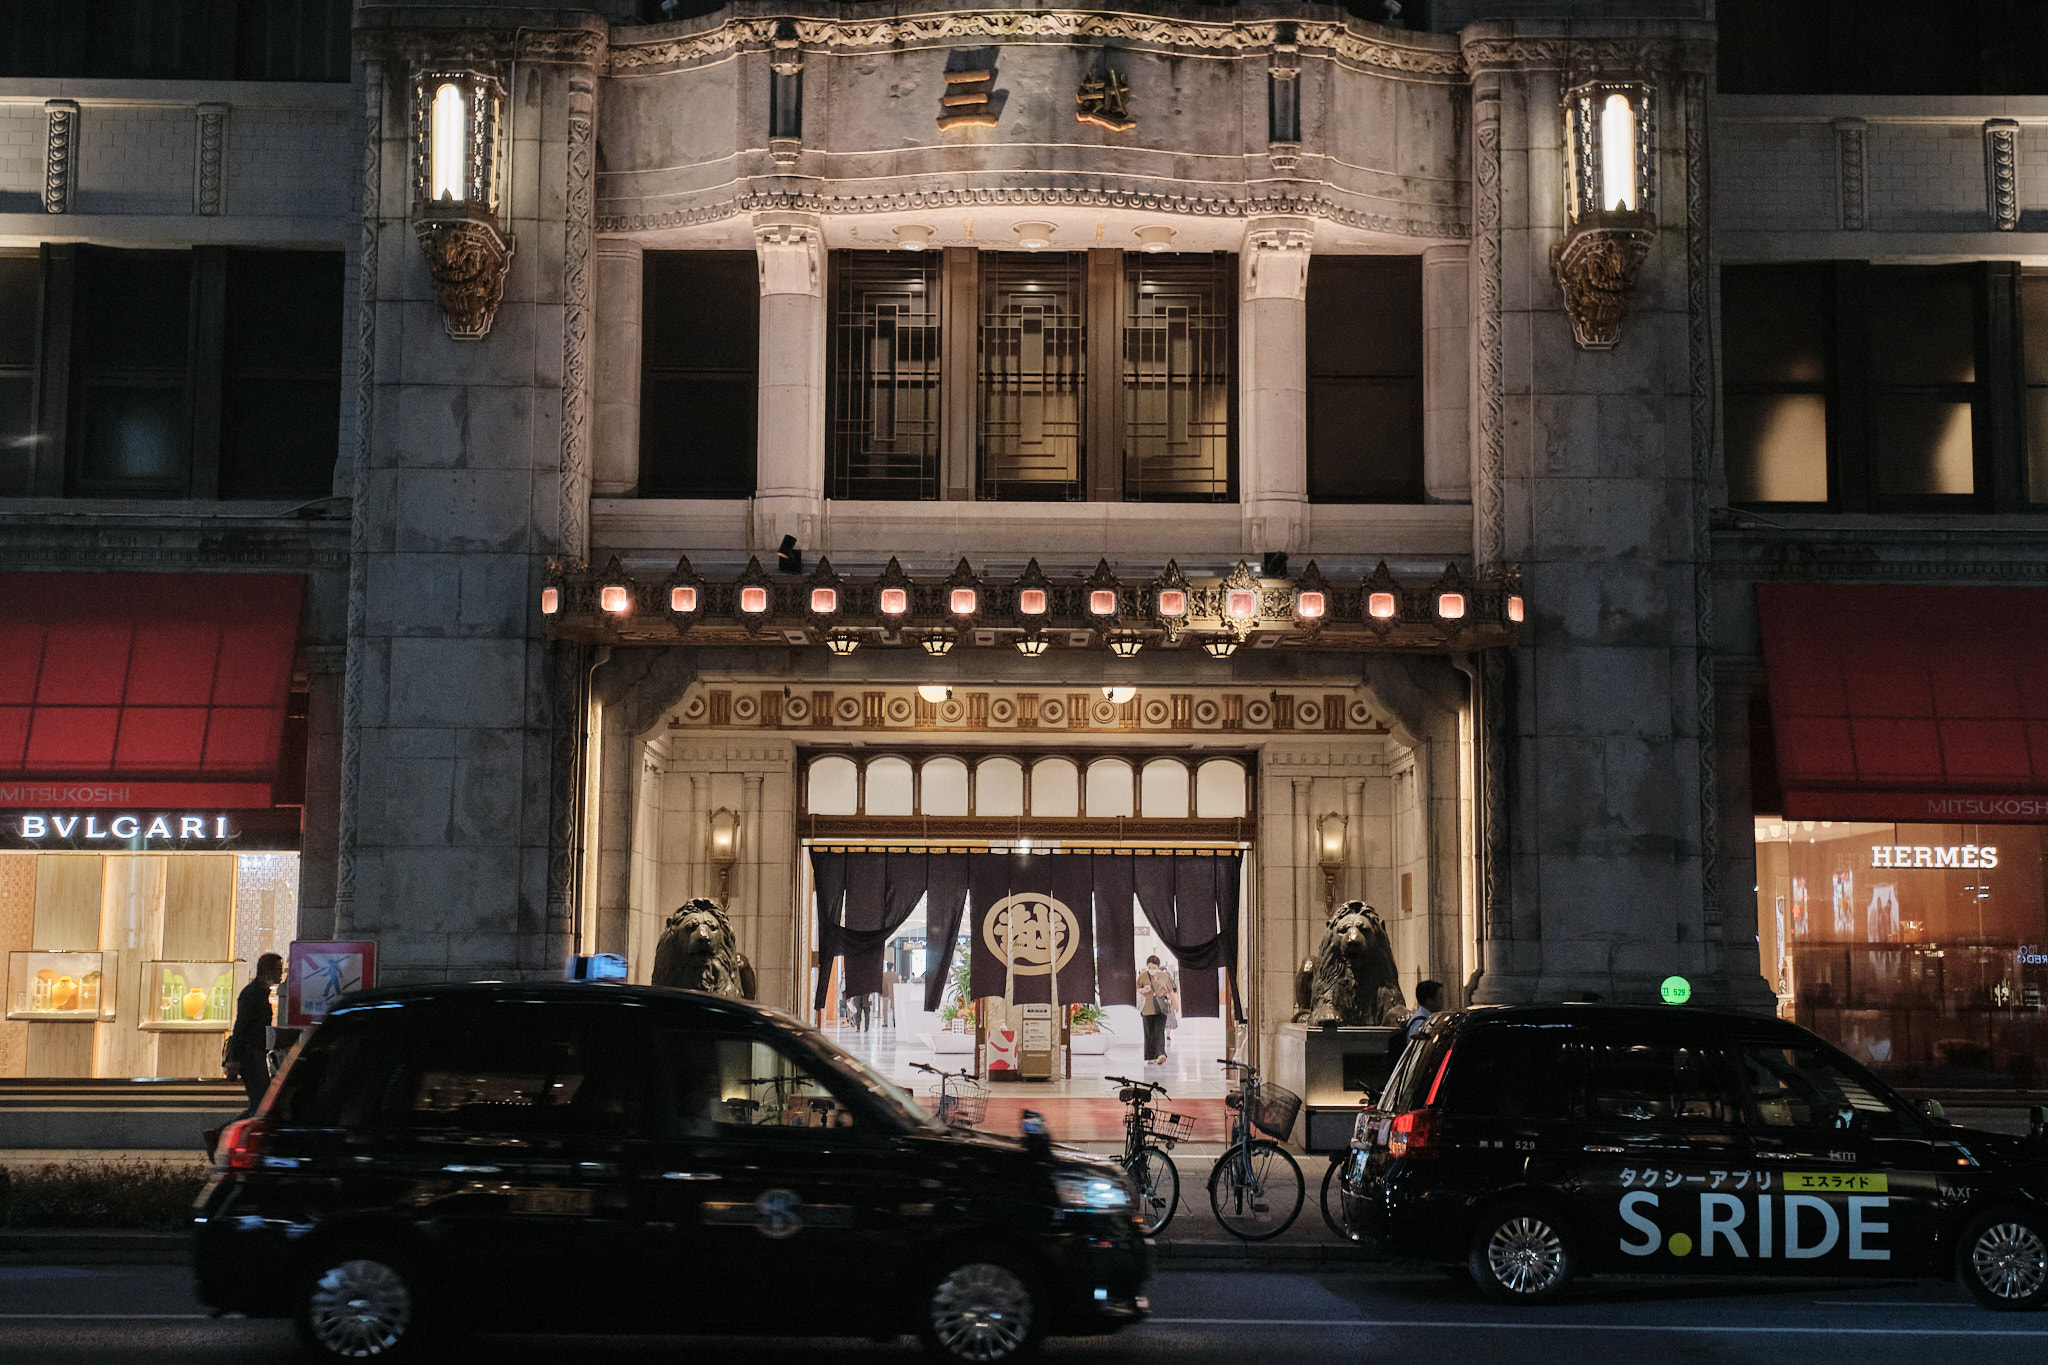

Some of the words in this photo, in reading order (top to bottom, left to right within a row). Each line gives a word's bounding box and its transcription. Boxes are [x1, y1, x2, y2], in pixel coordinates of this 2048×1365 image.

[0, 787, 130, 801] MITSUKOSHI
[21, 816, 228, 838] BVLGARI
[1673, 988, 1686, 996] 529
[1515, 1141, 1535, 1149] 529
[1619, 1168, 1771, 1190] タクシーアプリ
[1802, 1176, 1869, 1188] エスライド
[1619, 1190, 1891, 1260] S.RIDE
